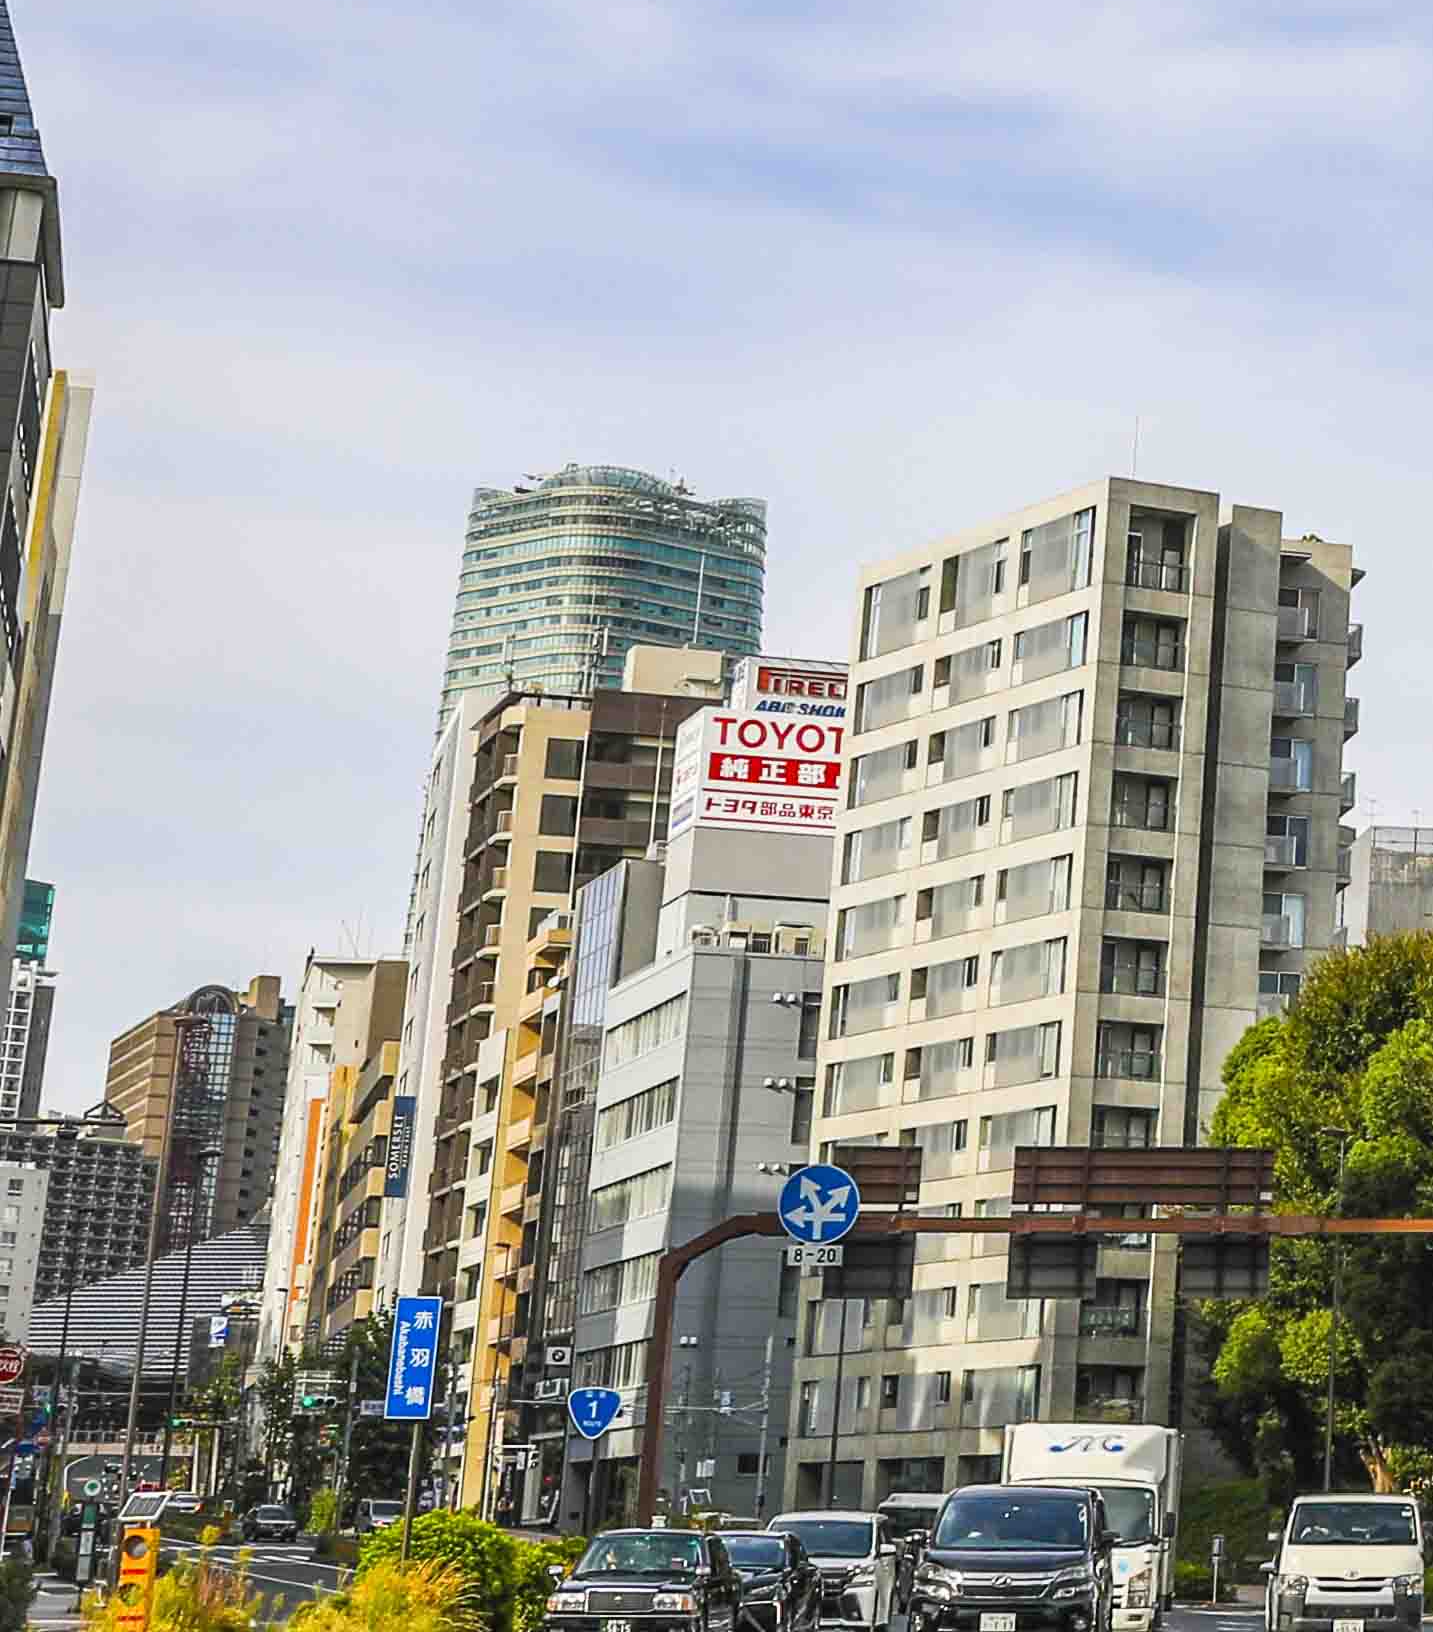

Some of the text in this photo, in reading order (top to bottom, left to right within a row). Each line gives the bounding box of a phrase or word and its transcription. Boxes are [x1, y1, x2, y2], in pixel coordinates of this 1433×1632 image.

[388, 1114, 405, 1180] SOMERSET
[793, 1248, 836, 1263] 8-20
[405, 1310, 434, 1407] 赤羽橋
[587, 1399, 599, 1419] 1
